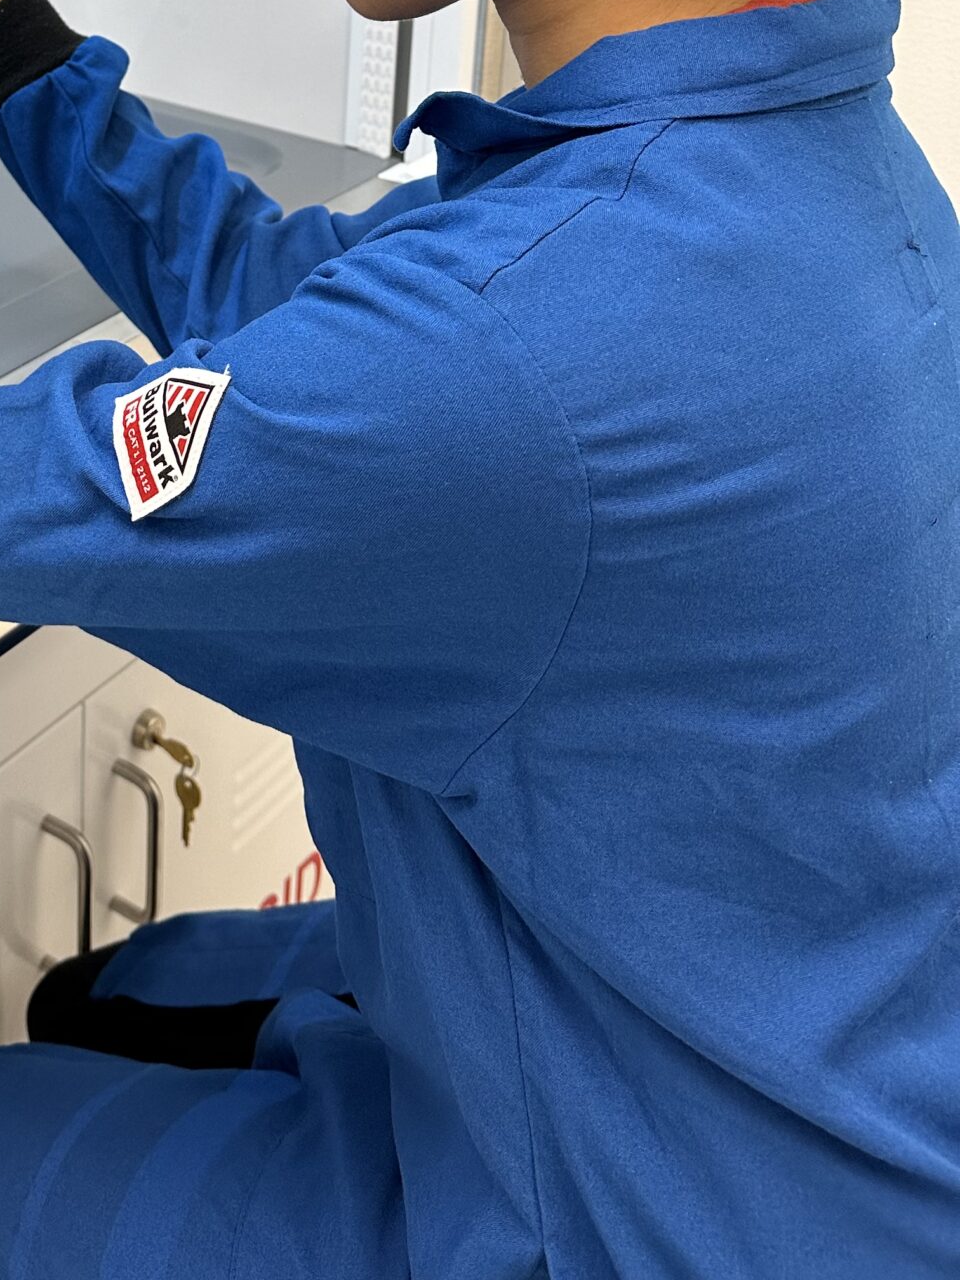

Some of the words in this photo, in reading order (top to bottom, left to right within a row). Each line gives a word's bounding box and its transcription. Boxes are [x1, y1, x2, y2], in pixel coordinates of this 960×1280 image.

[125, 403, 138, 426] FR
[128, 428, 140, 450] CAT
[137, 466, 151, 494] 2112
